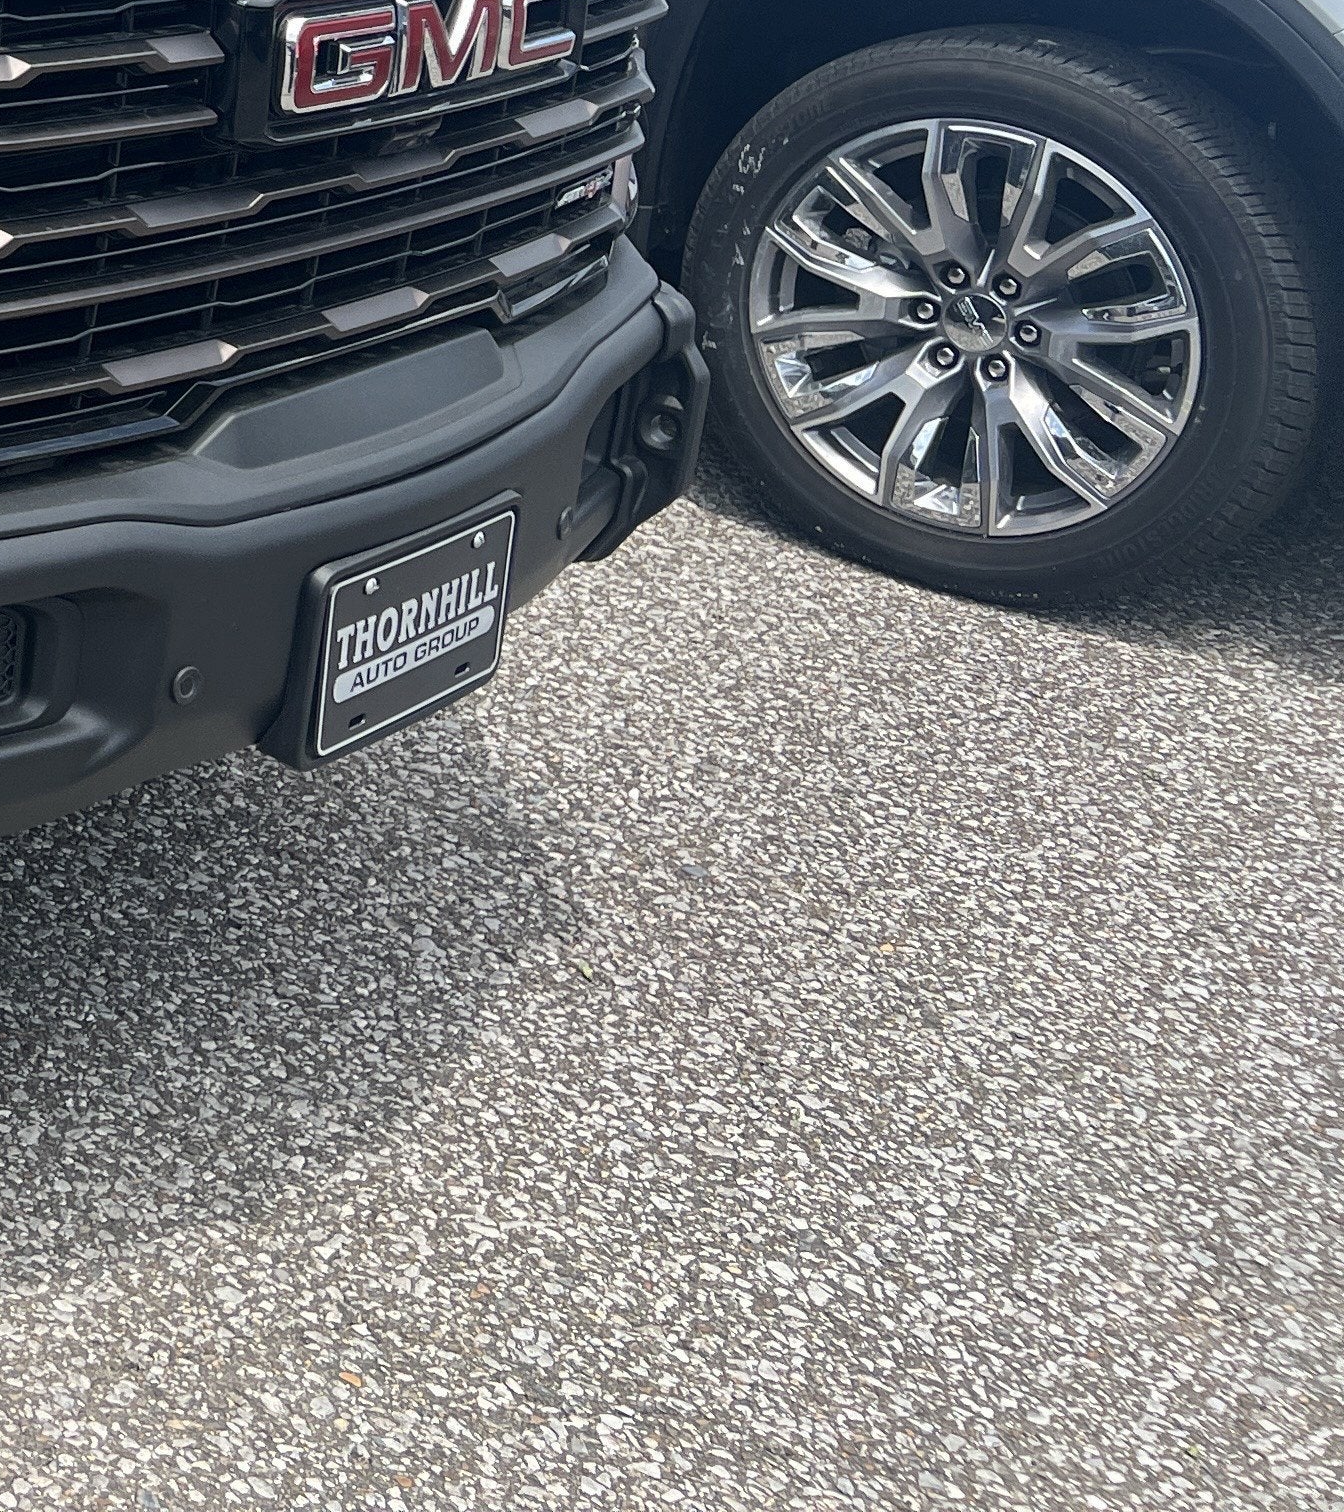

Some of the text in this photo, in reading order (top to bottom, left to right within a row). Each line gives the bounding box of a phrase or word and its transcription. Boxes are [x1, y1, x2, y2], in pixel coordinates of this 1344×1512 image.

[337, 561, 499, 670] THORNHILL
[350, 615, 480, 693] AUTO GROUP
